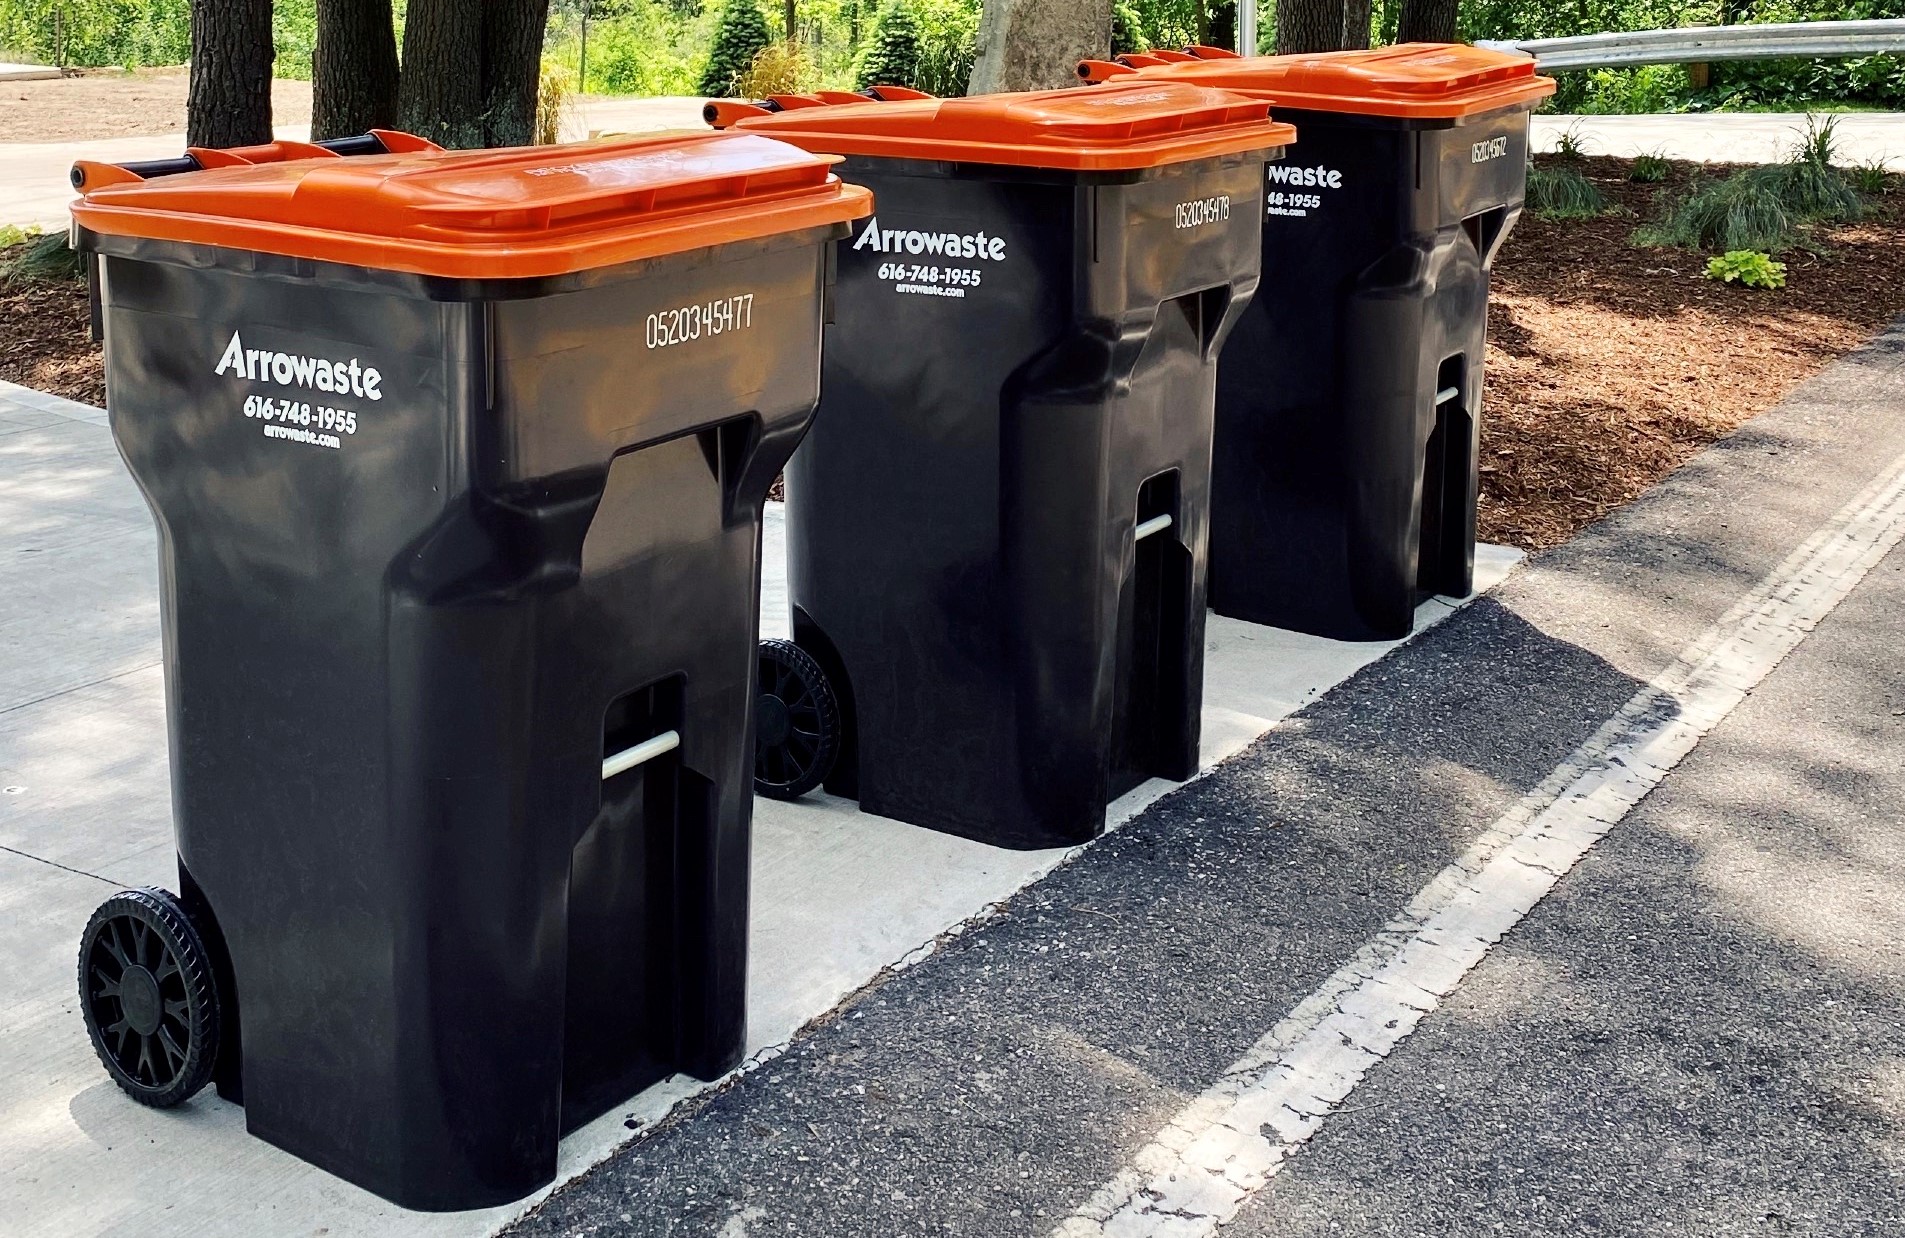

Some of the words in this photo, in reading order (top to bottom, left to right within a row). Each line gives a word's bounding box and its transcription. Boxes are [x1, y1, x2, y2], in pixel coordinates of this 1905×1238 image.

[1269, 165, 1342, 188] waste
[1175, 196, 1230, 229] 0520345478
[1267, 192, 1321, 208] 48-1955
[1267, 207, 1307, 217] aste.com
[853, 216, 1006, 261] Arrowaste
[878, 263, 981, 286] 616-748-1955
[896, 283, 965, 298] arrowaste.com
[646, 294, 754, 349] 0520345477
[214, 329, 382, 401] Arrowaste
[243, 395, 357, 435] 616-748-1955
[263, 424, 340, 449] arrowaste.com
